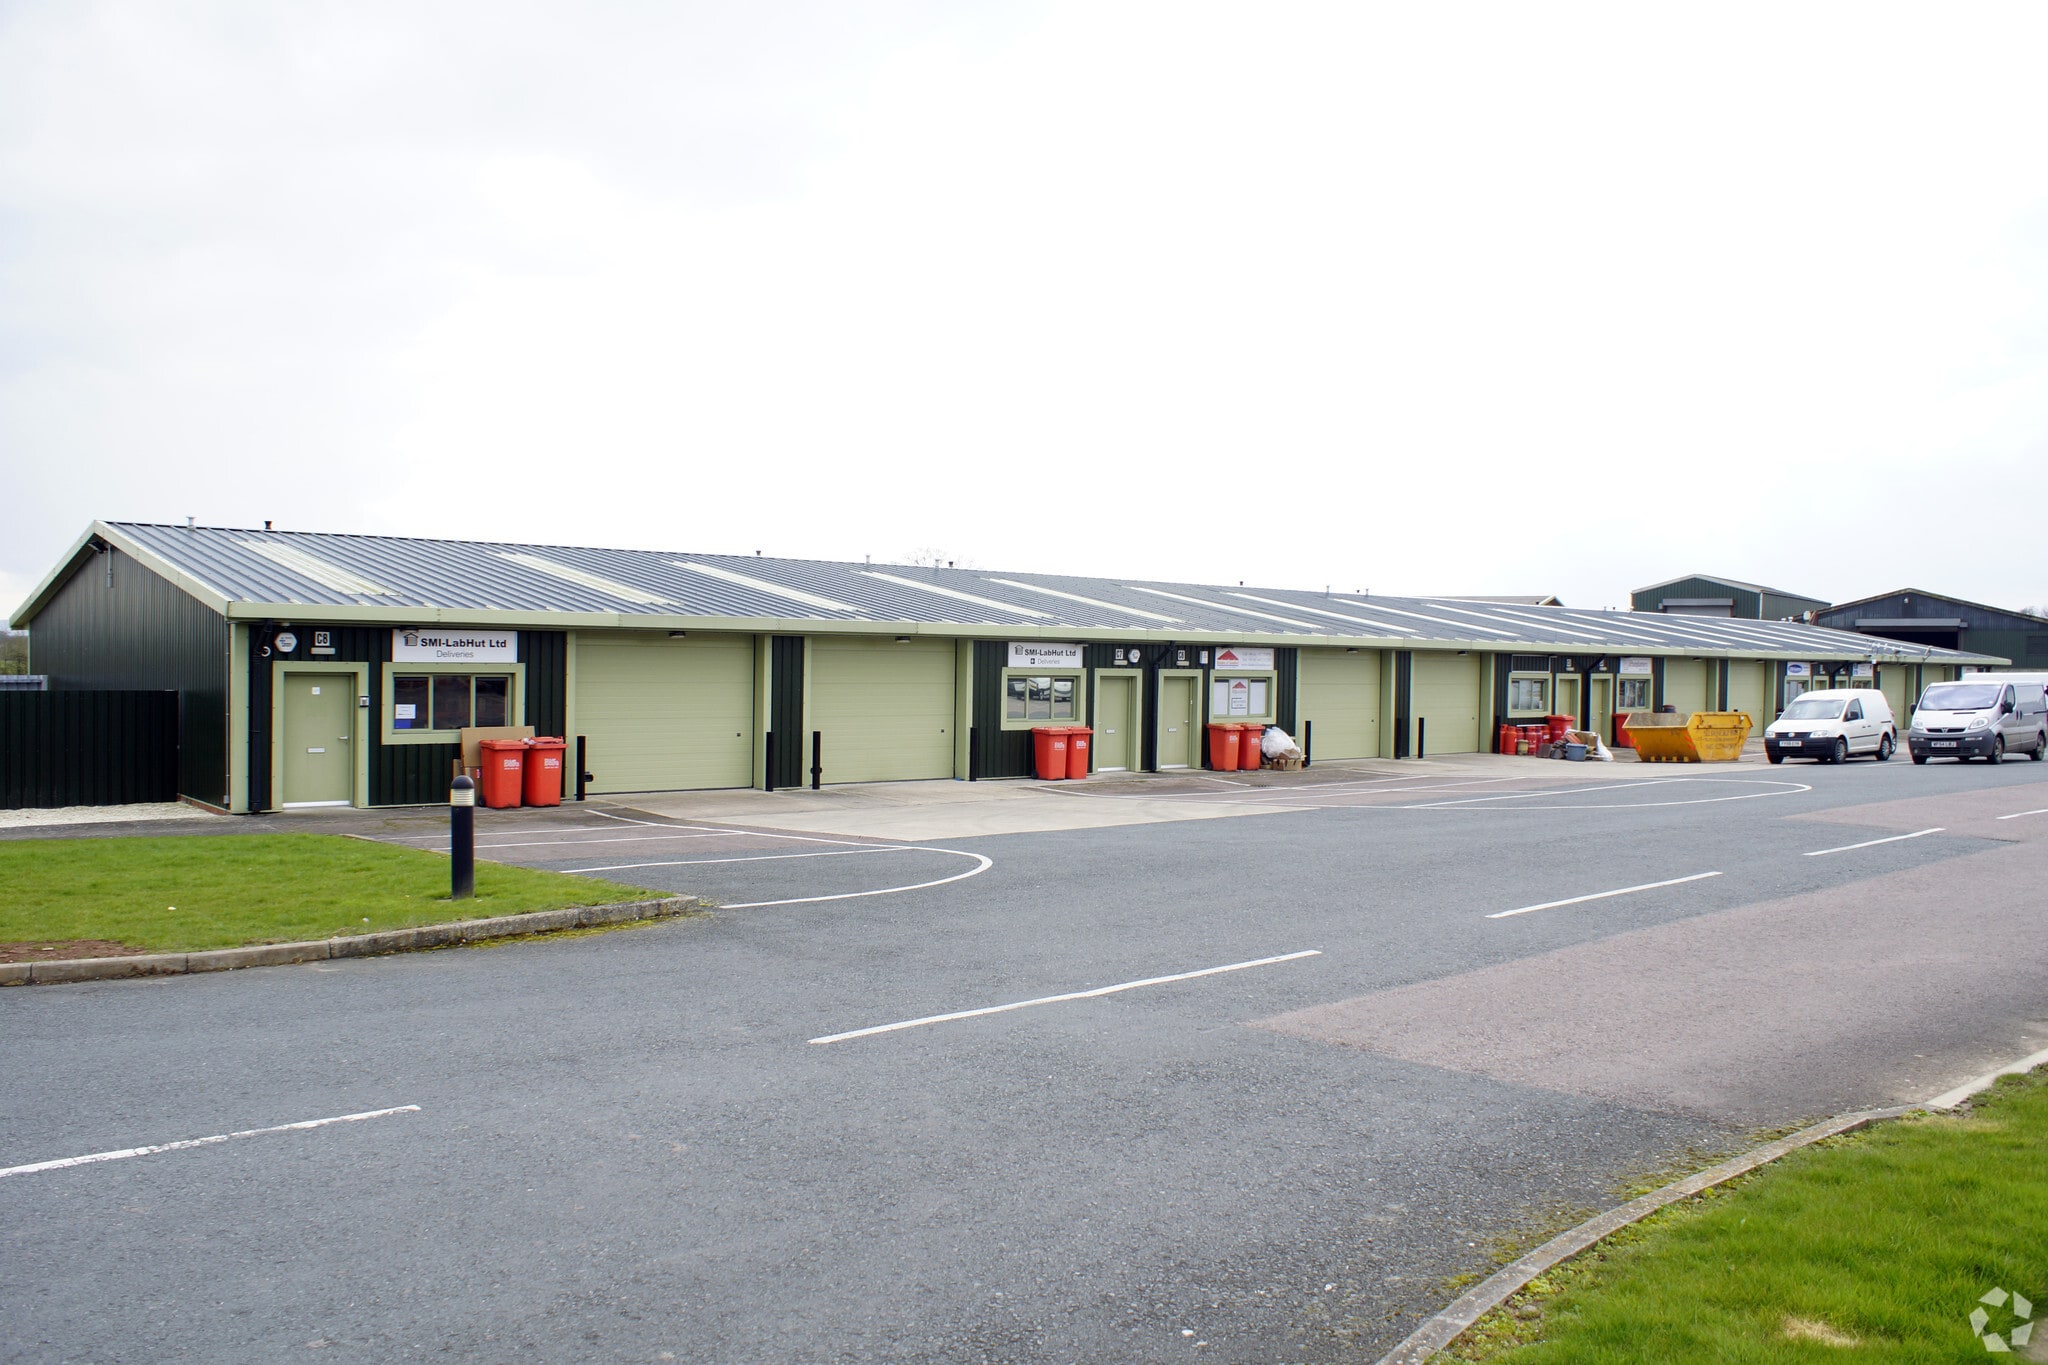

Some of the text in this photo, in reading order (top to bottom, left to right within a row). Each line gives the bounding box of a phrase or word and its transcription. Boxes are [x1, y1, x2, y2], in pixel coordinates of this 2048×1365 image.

[316, 633, 328, 644] C8
[420, 638, 507, 648] SMI-LabHut Ltd
[436, 650, 474, 658] Deliveries
[1024, 648, 1064, 657] SMI-LabHut
